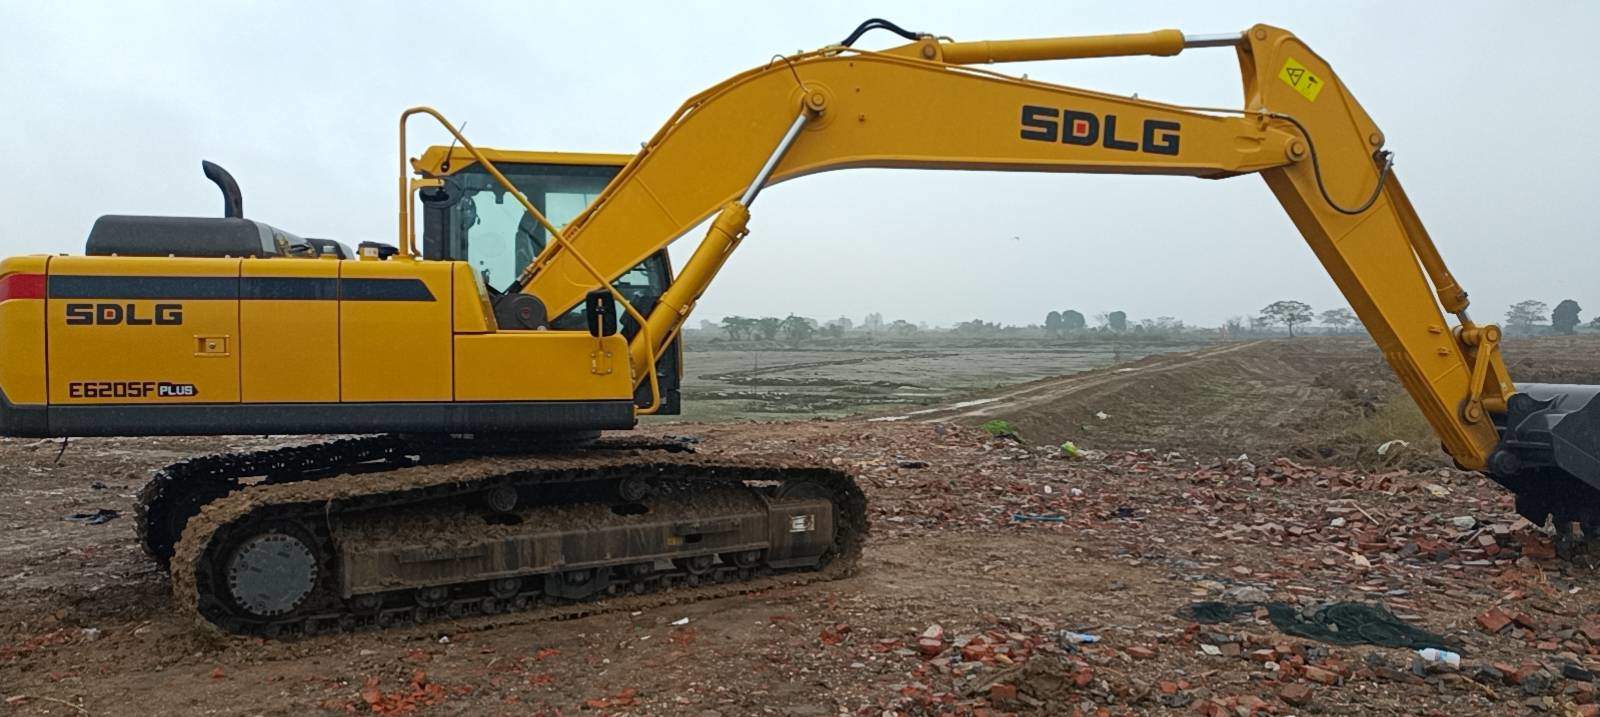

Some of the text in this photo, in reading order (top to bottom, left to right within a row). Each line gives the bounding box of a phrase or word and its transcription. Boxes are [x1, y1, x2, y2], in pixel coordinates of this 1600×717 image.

[1021, 105, 1181, 156] SDLG
[66, 304, 183, 325] SDLG
[159, 385, 194, 396] PLUS
